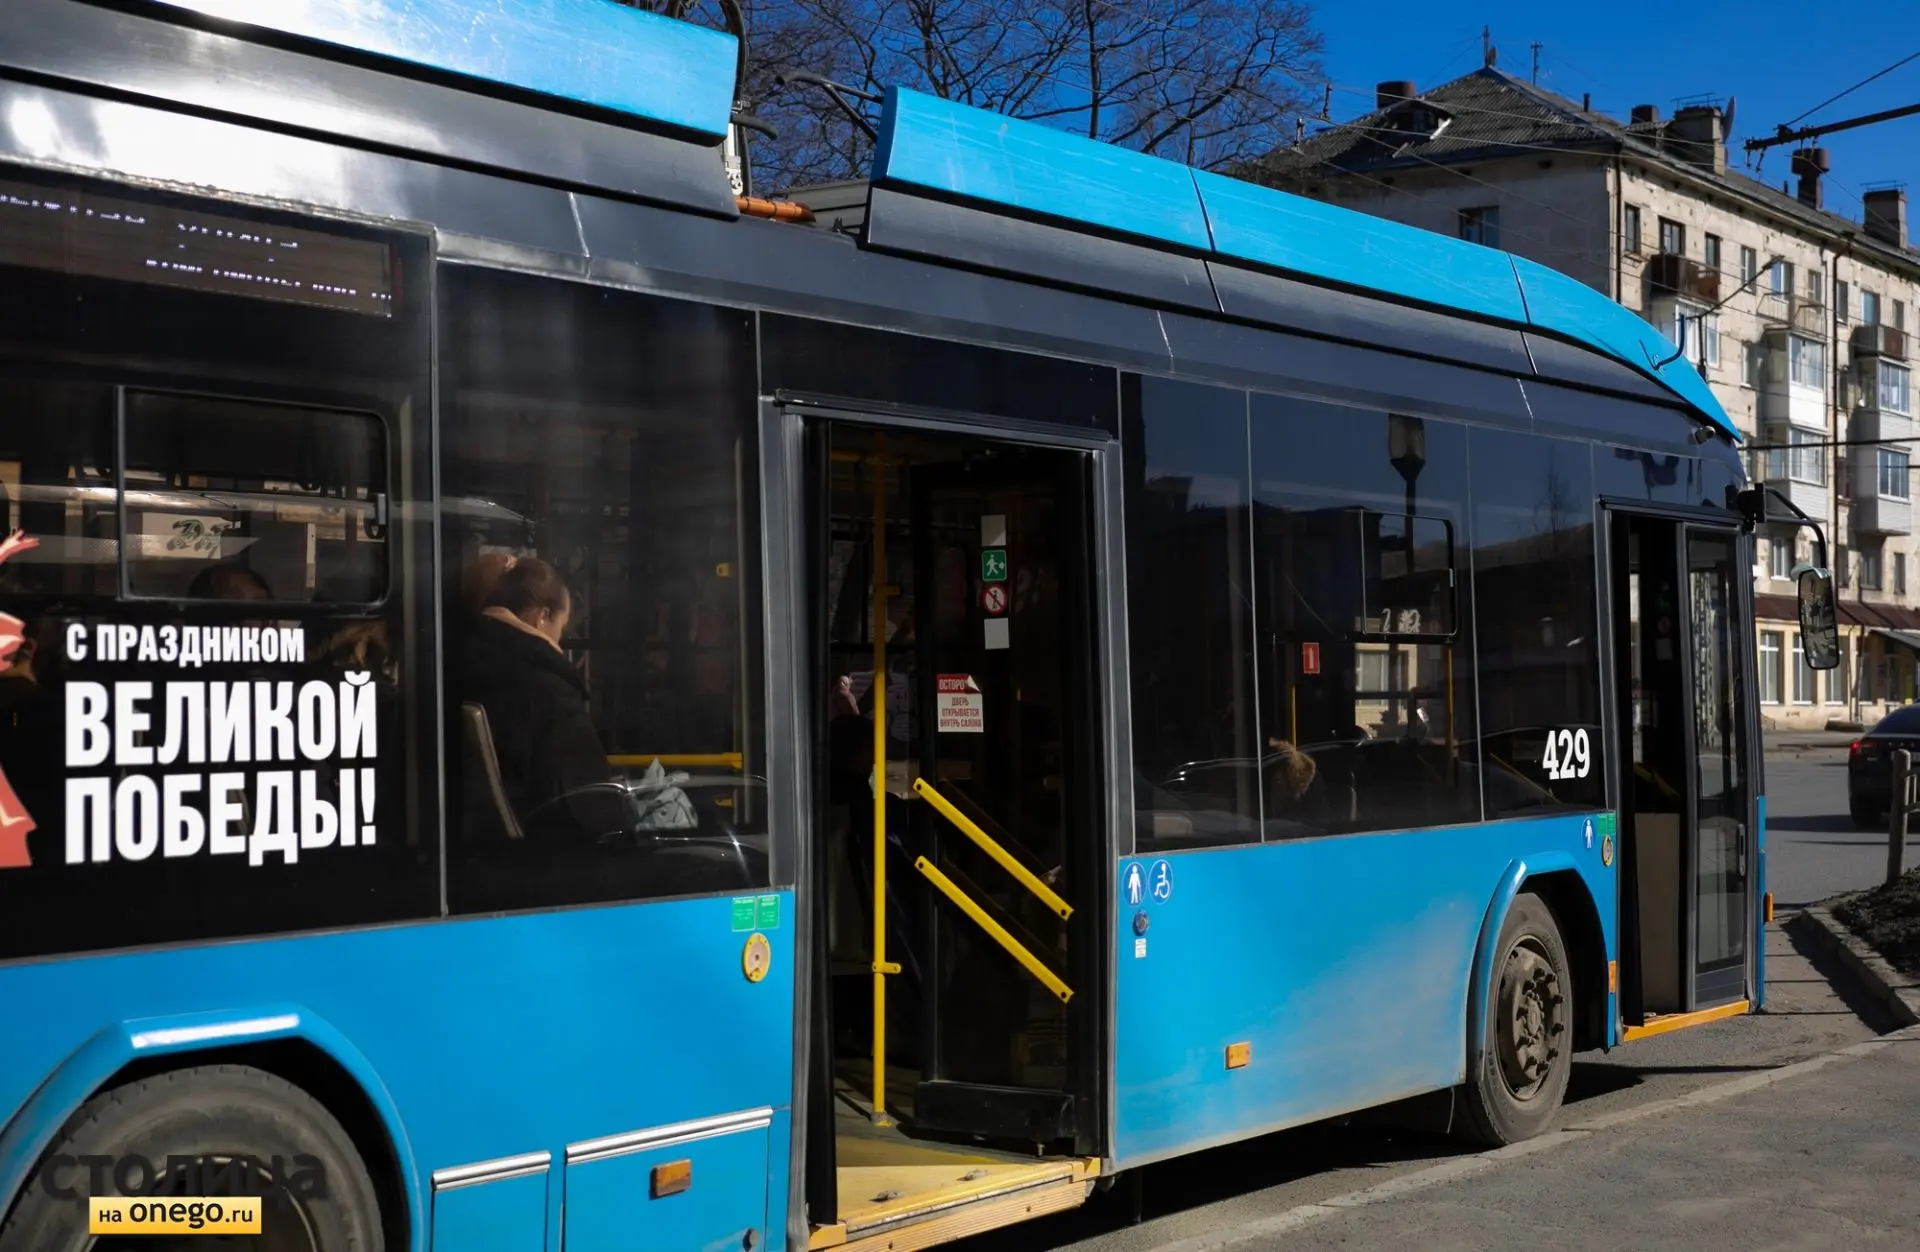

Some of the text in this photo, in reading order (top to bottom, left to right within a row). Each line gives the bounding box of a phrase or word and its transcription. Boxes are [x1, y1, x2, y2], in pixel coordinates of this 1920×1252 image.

[66, 623, 305, 668] С ПРАЗДНИКОМ
[939, 678, 968, 690] ОСТОРО
[65, 671, 377, 767] ВЕЛИКОЙ
[1542, 728, 1591, 780] 429
[65, 768, 377, 866] ПОБЕДЫ!
